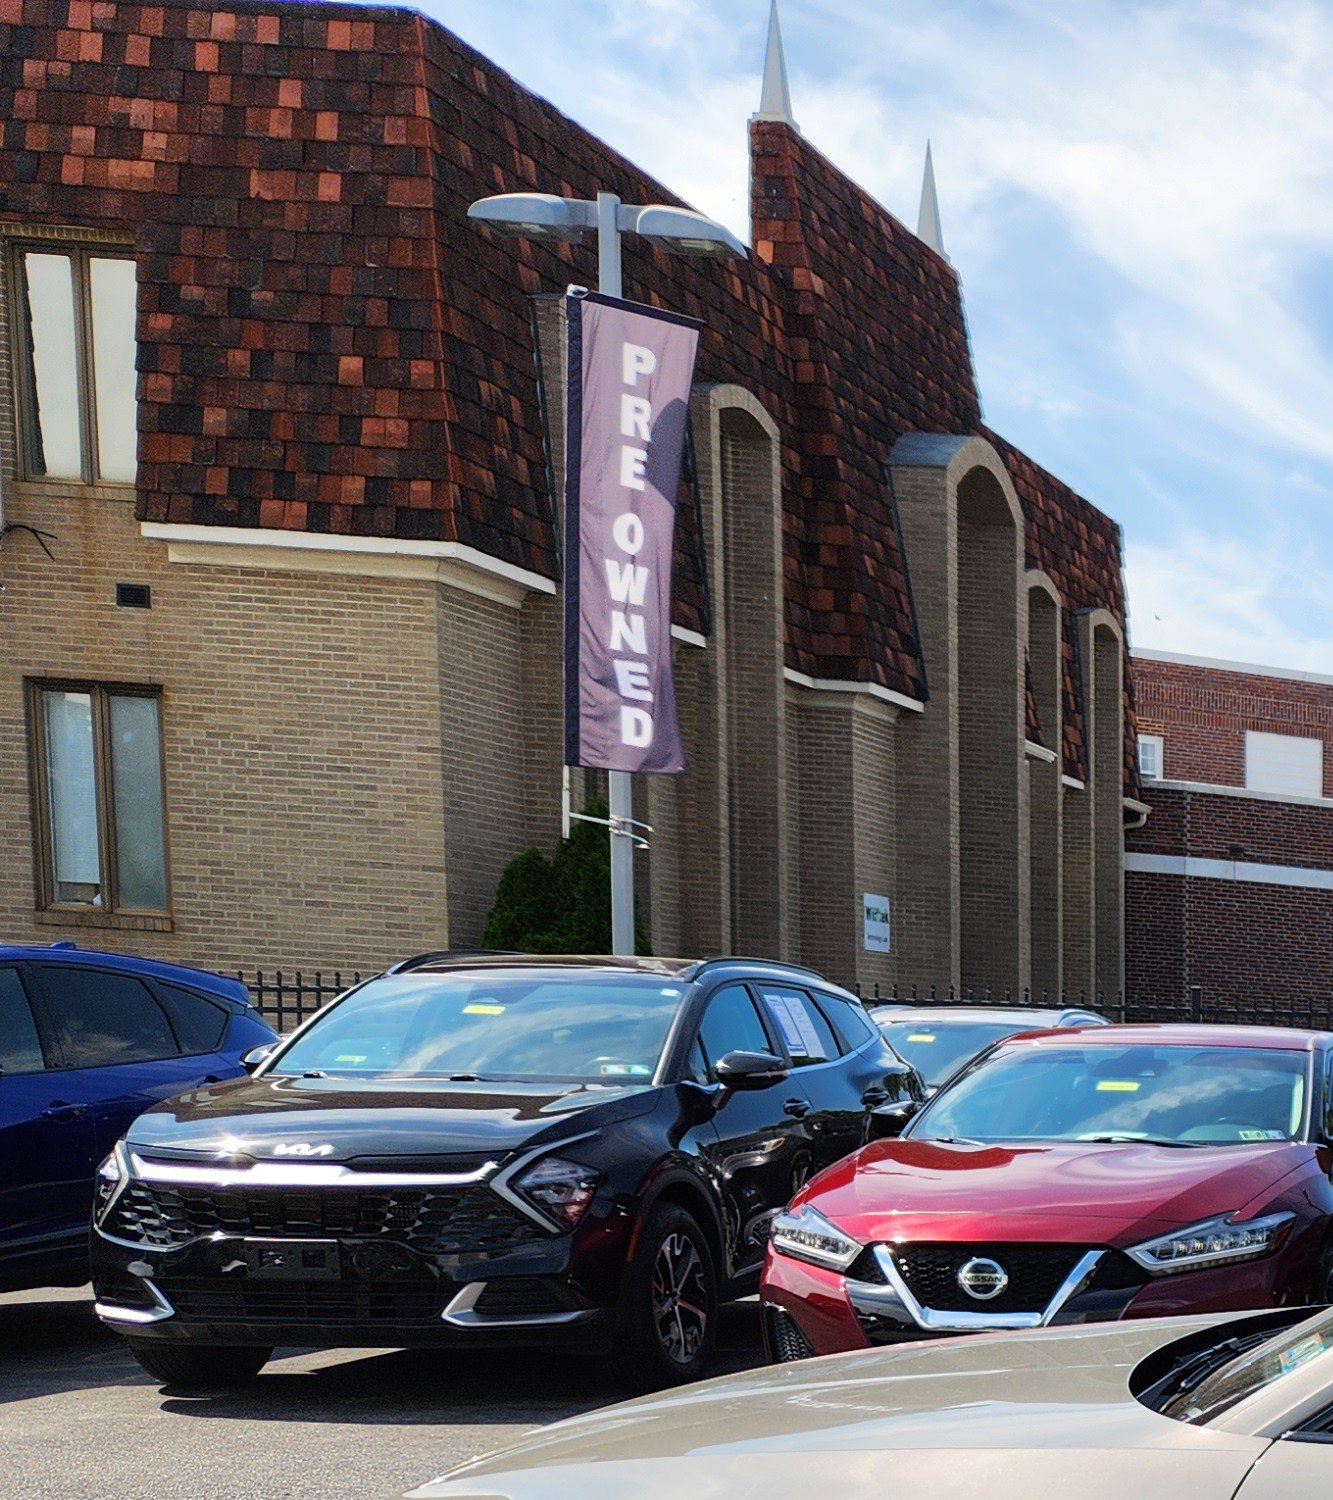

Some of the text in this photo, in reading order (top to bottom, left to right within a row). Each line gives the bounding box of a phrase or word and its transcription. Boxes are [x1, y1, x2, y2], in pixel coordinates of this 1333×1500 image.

[605, 341, 658, 749] PRE OWNED
[963, 1275, 1003, 1283] NISSAN
